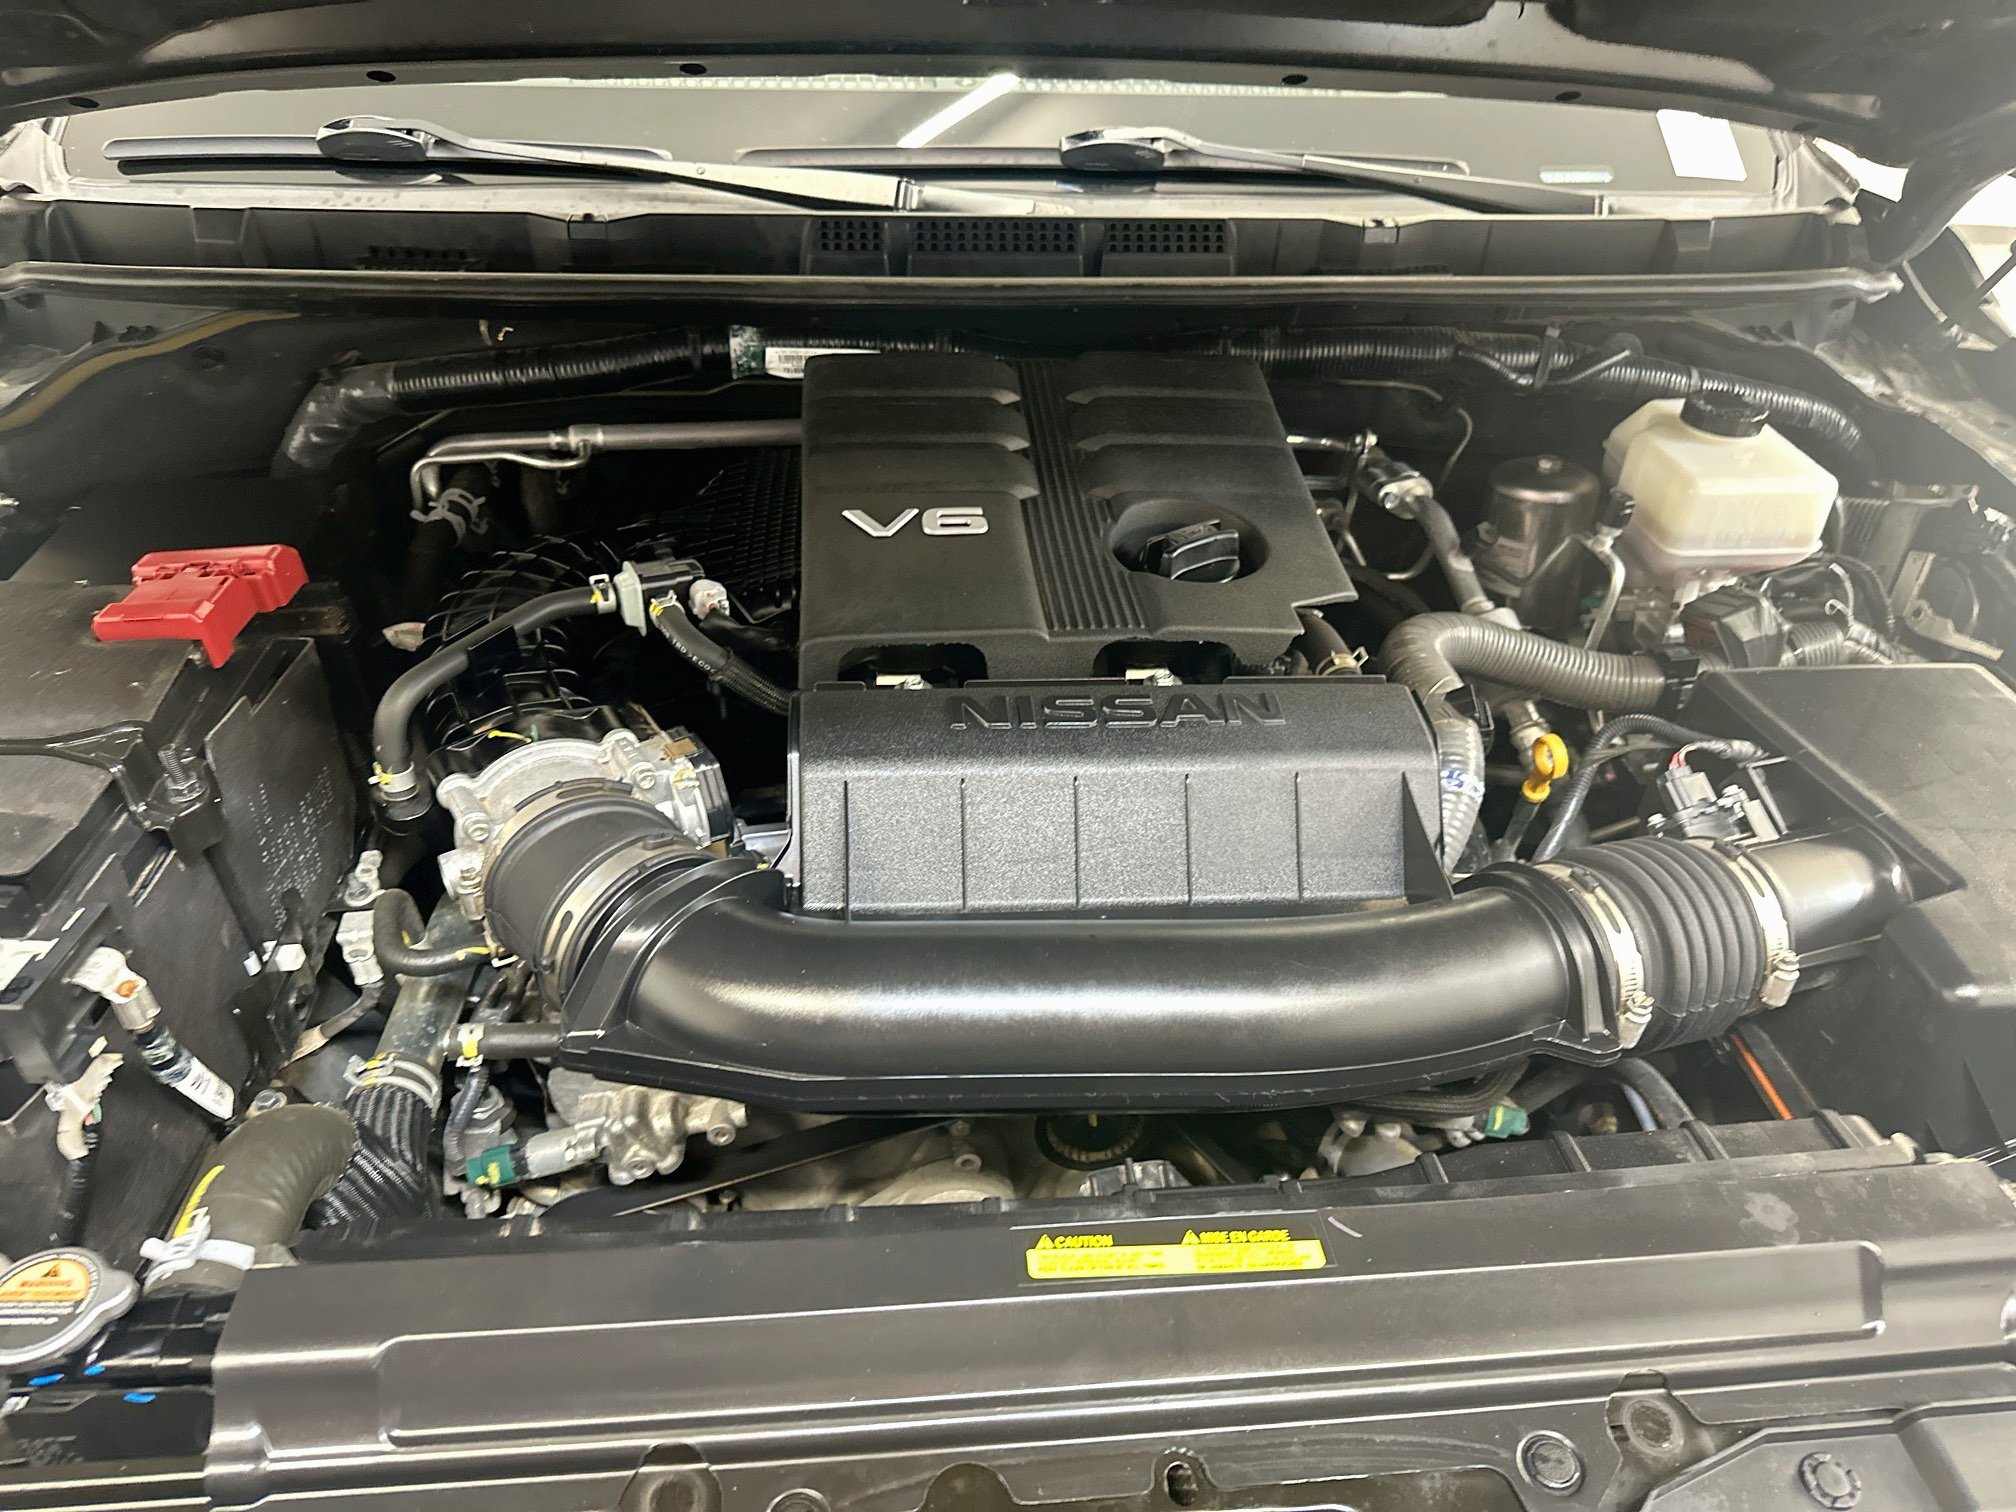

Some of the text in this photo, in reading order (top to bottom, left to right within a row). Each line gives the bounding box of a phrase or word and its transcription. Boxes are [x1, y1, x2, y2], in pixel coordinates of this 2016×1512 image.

[841, 506, 989, 537] V6
[949, 694, 1286, 730] NISSAN
[1053, 1234, 1114, 1248] CAUTION
